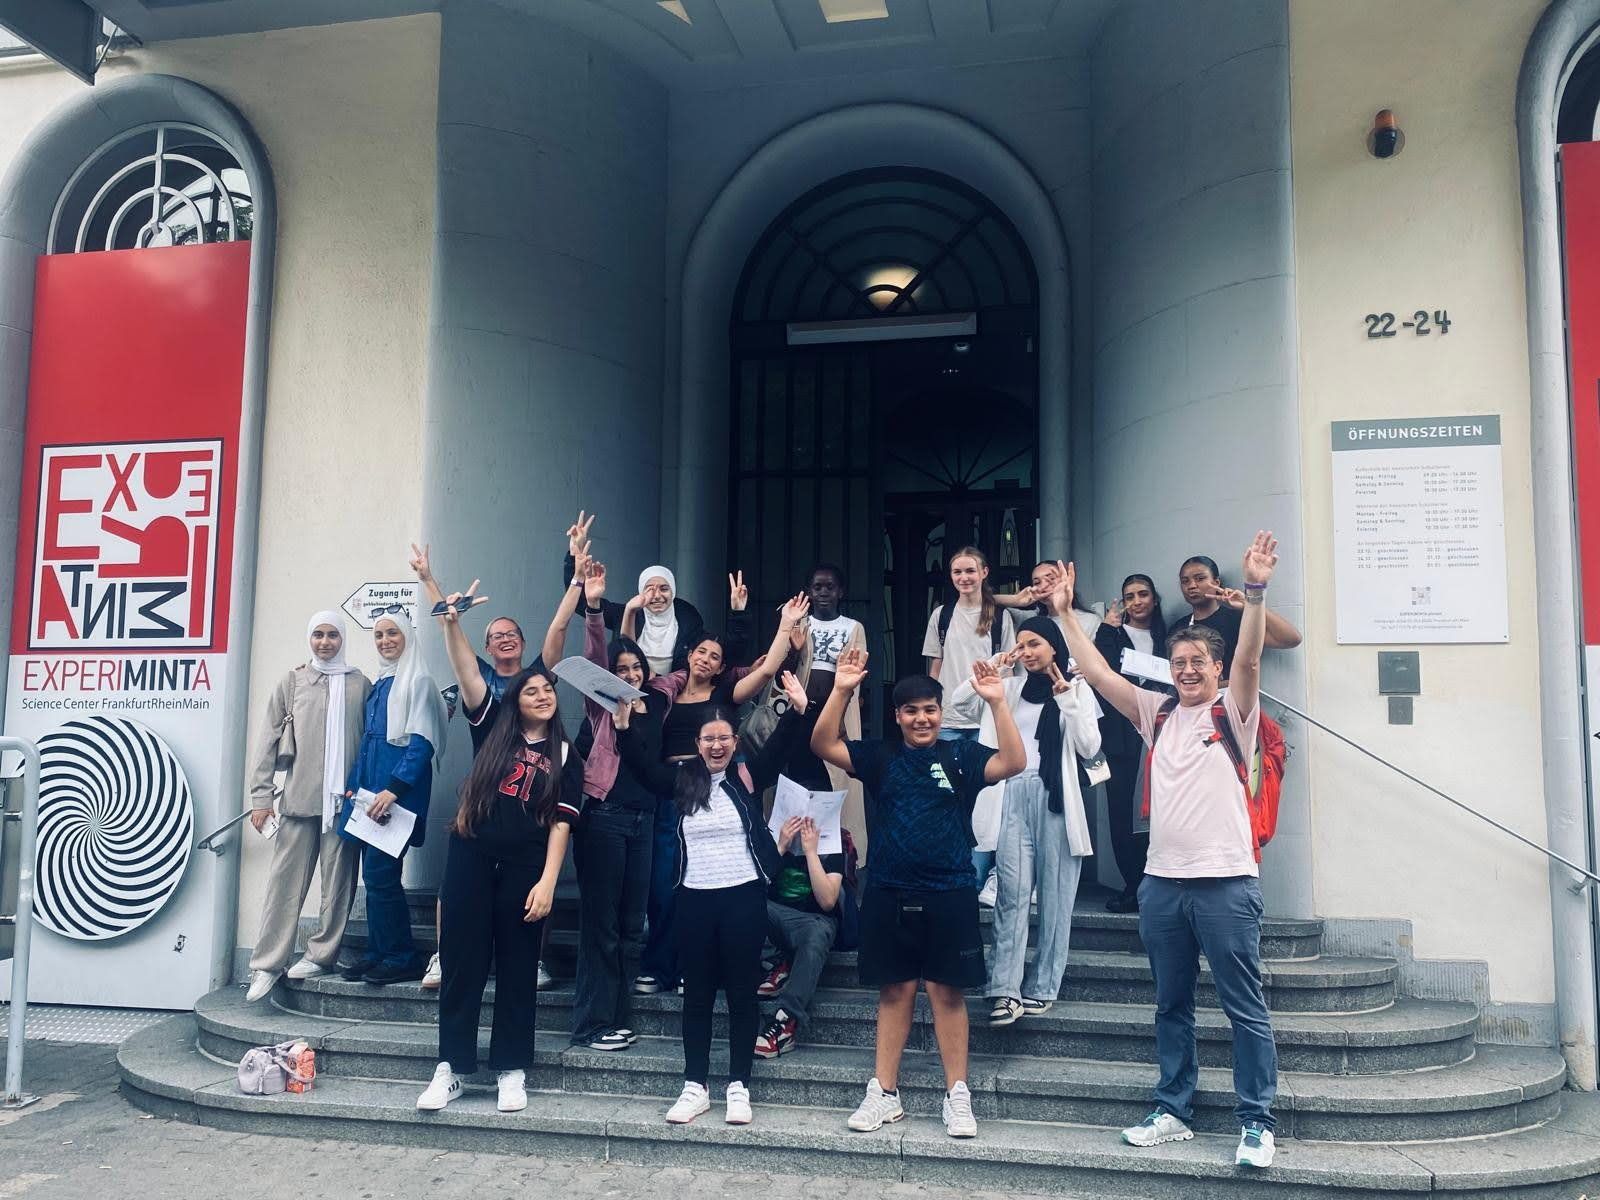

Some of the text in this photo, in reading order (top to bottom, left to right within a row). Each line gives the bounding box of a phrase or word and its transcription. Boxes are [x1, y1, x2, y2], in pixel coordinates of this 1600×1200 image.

[1348, 424, 1483, 441] ÖFFNUNGSZEITEN
[368, 588, 413, 598] Zugang für
[23, 659, 211, 691] EXPERIMINTA
[22, 698, 62, 709] Science
[63, 698, 99, 709] Center
[498, 762, 536, 802] 21
